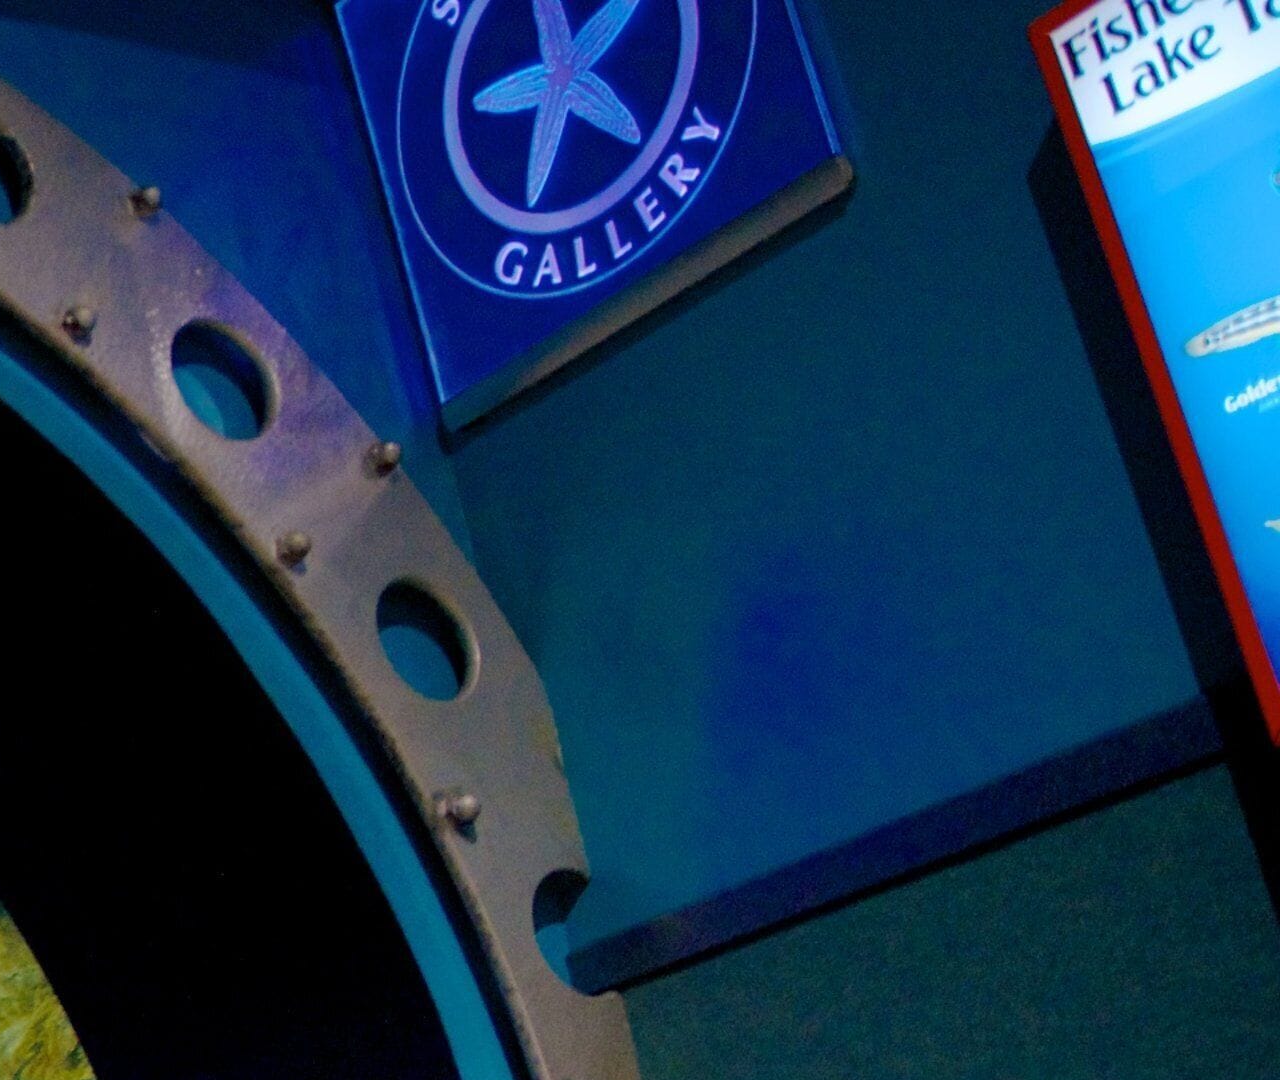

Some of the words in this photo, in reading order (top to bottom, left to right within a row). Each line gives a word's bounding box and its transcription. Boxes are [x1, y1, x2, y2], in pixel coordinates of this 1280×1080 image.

[1103, 24, 1222, 114] Lake
[495, 106, 721, 287] GALLERY
[1224, 373, 1280, 413] Golde
